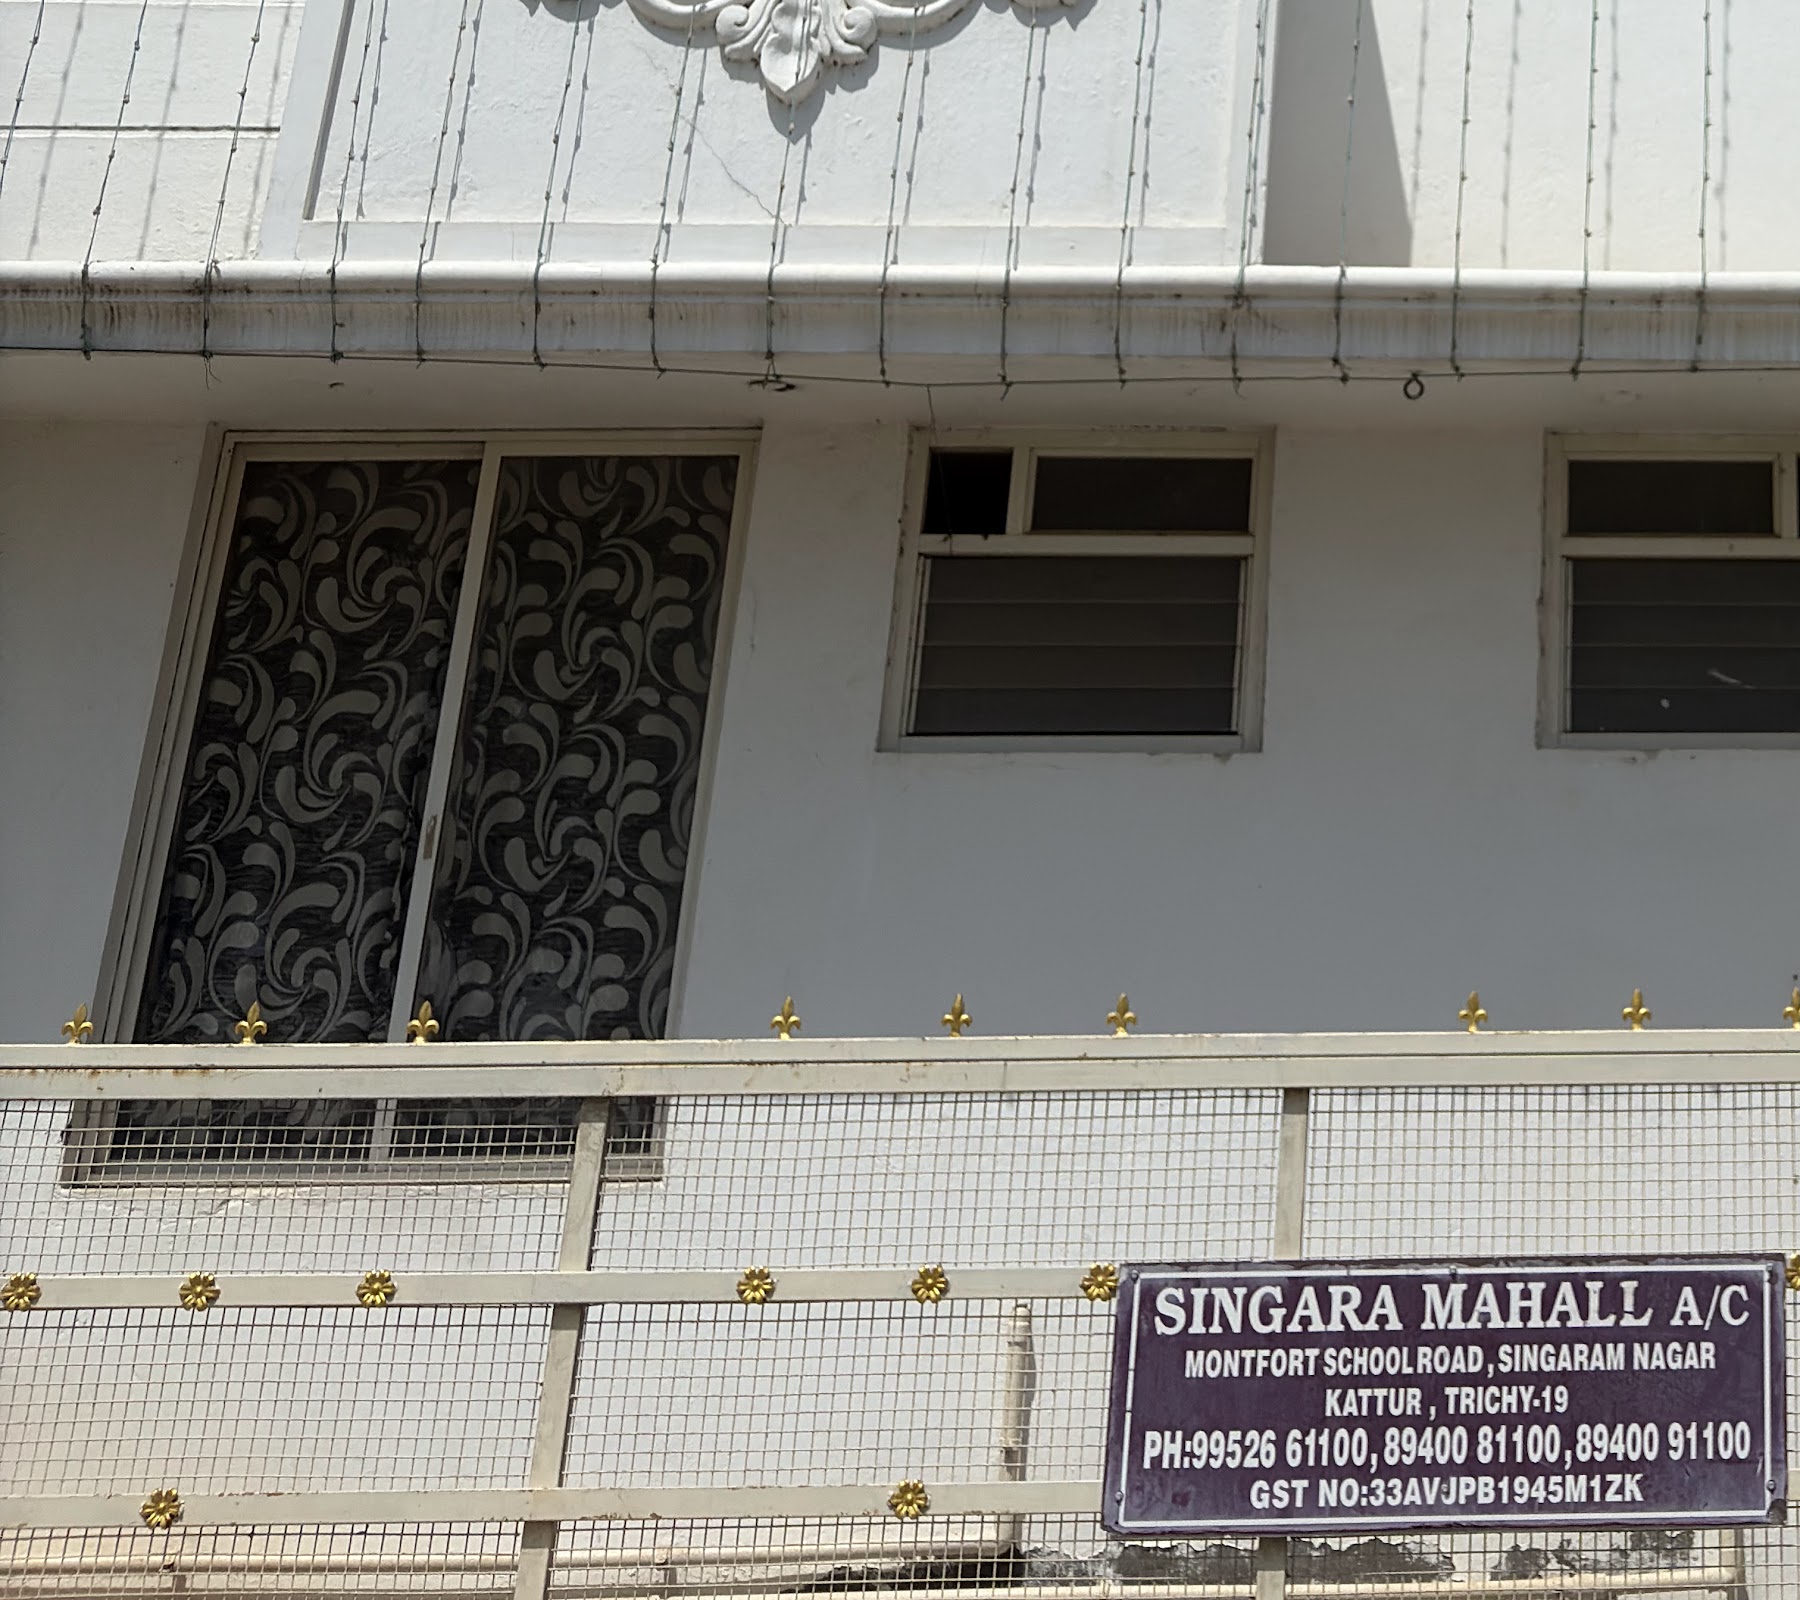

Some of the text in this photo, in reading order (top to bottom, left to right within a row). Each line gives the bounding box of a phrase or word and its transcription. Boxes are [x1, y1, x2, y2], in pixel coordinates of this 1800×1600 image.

[1154, 1281, 1750, 1335] SINGARA MAHALL A/C
[1184, 1347, 1320, 1378] MONTFORT
[1322, 1346, 1414, 1376] SCHOOL
[1497, 1343, 1625, 1373] SINGARAM
[1633, 1341, 1716, 1370] NAGAR
[1444, 1385, 1569, 1415] TRICHY-19
[1143, 1429, 1277, 1469] PH:99526
[1285, 1427, 1378, 1473] 61100,
[1383, 1425, 1468, 1465] 89400
[1576, 1422, 1660, 1462] 89400
[1667, 1421, 1751, 1460] 91100
[1250, 1478, 1309, 1509] GST
